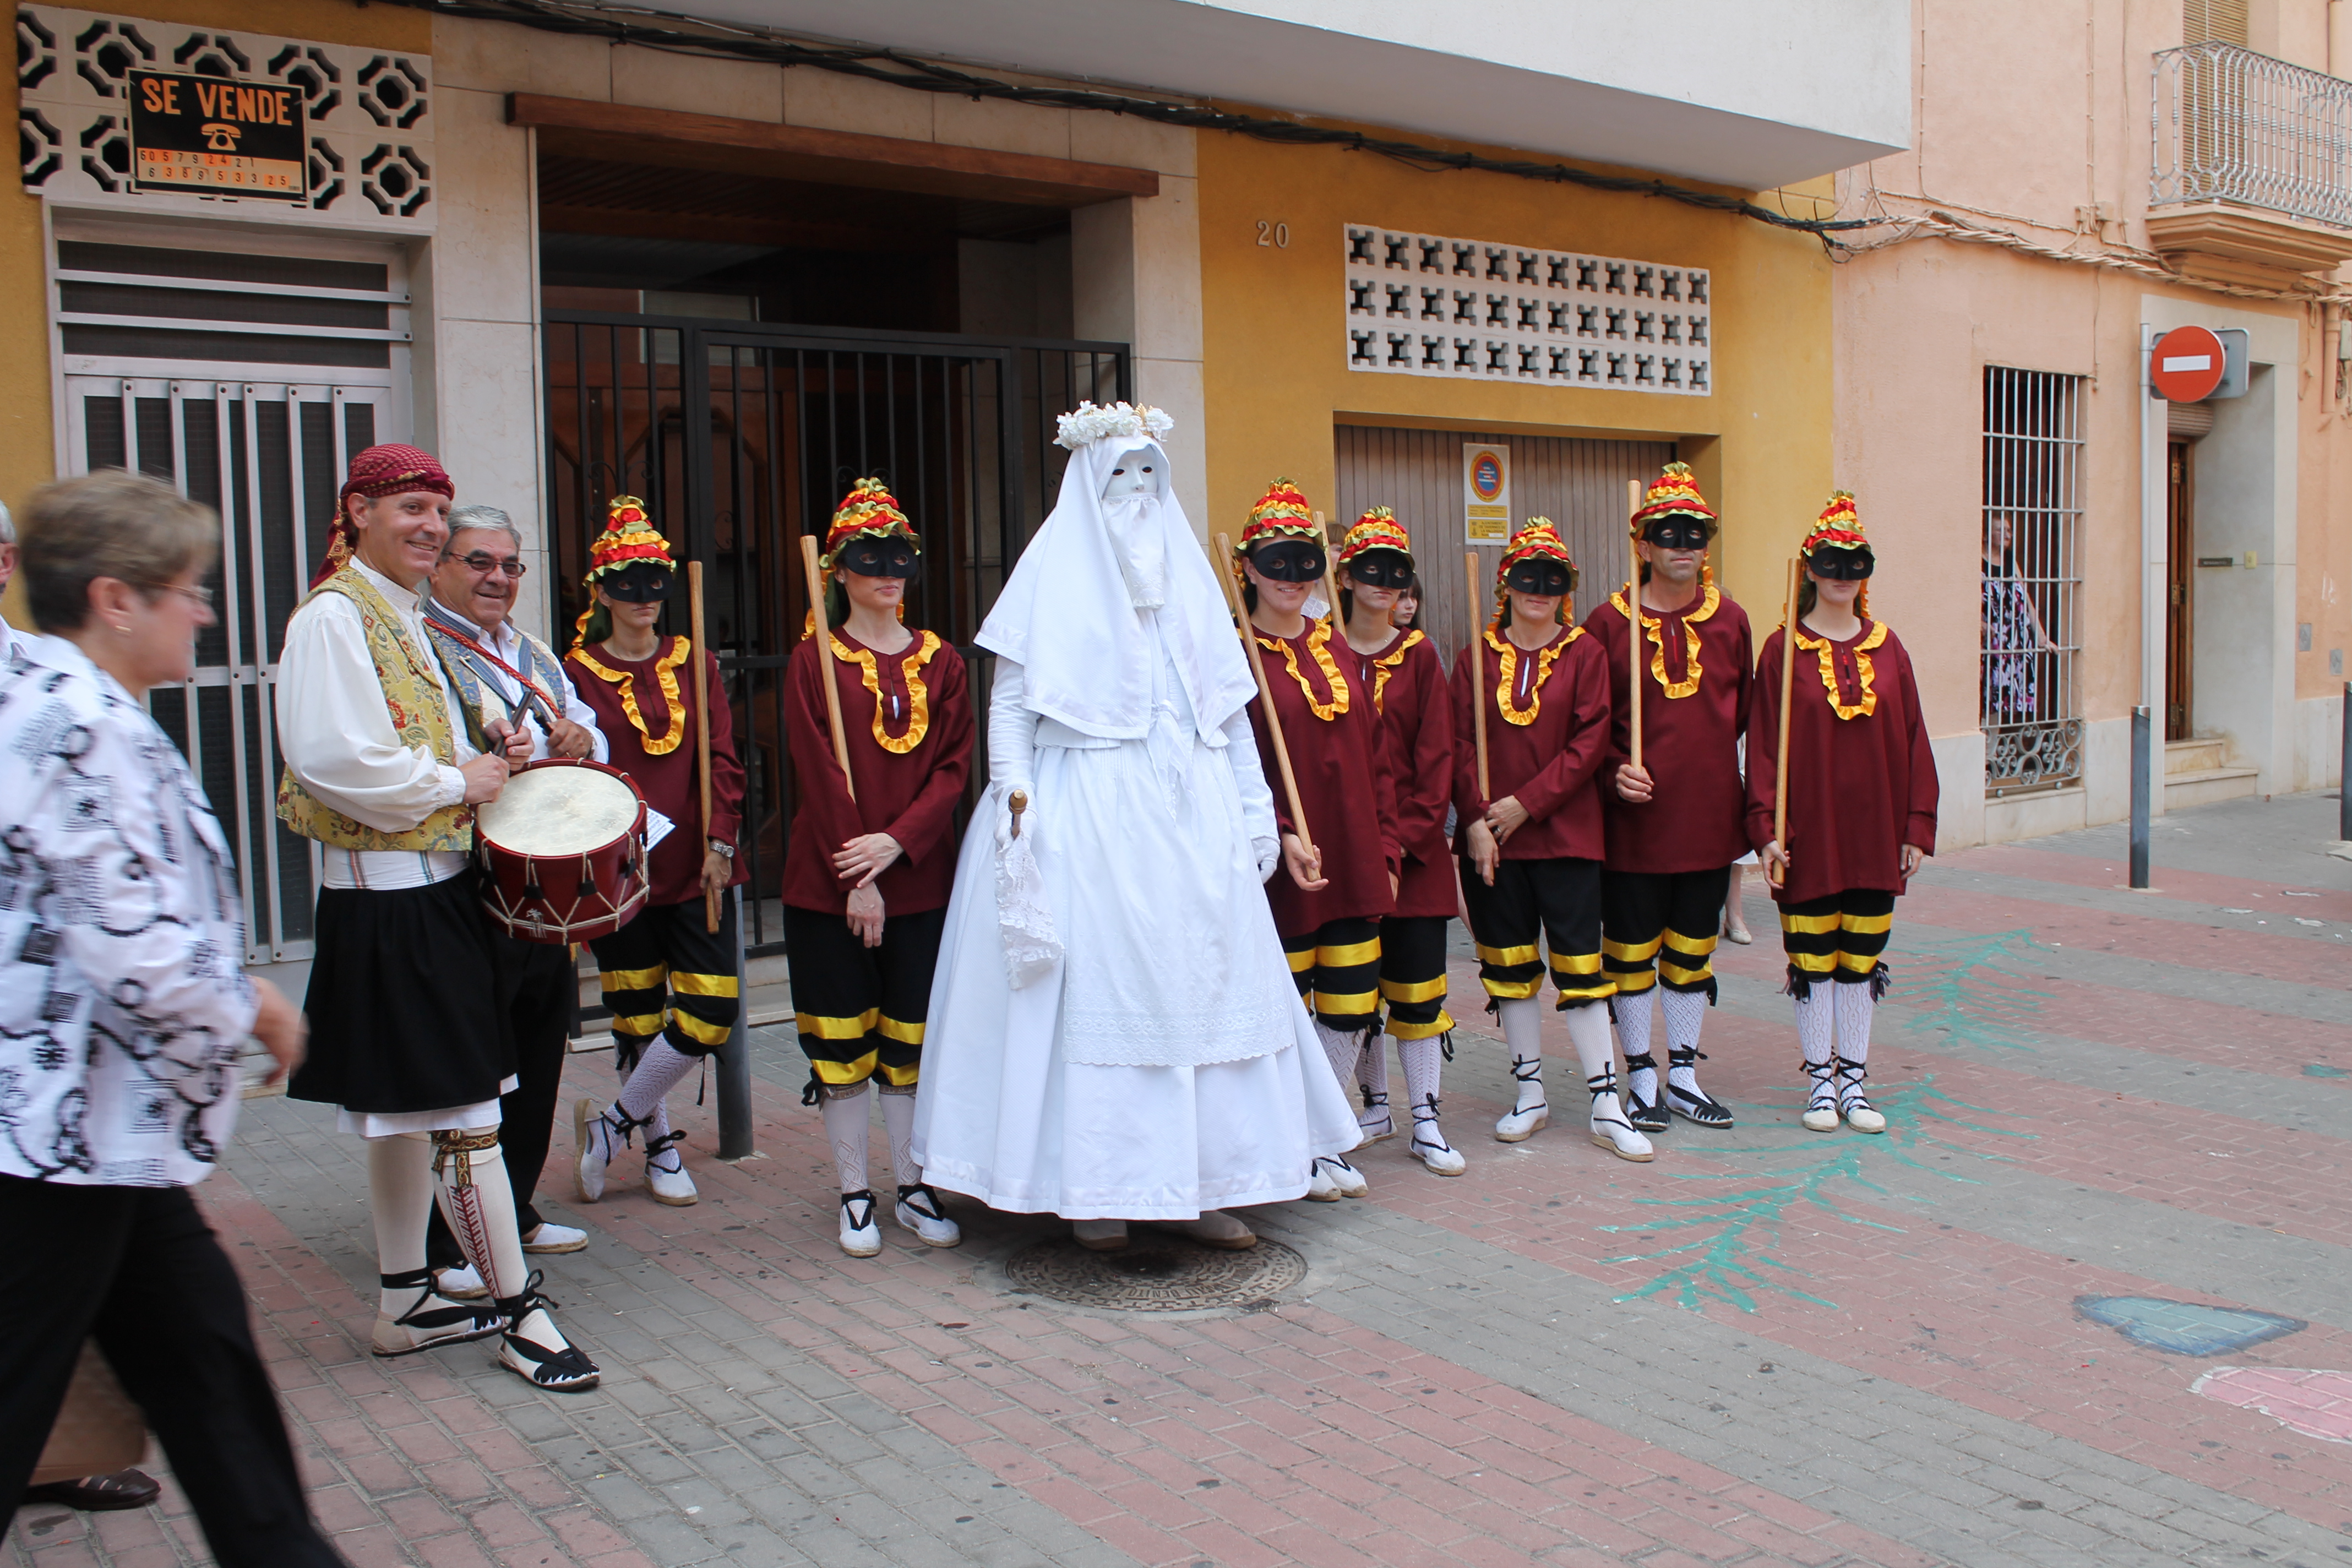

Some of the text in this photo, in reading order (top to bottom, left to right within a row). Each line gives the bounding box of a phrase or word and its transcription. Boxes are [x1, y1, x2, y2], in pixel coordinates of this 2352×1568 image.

[141, 78, 292, 126] SE VENDE
[1257, 221, 1289, 248] 20
